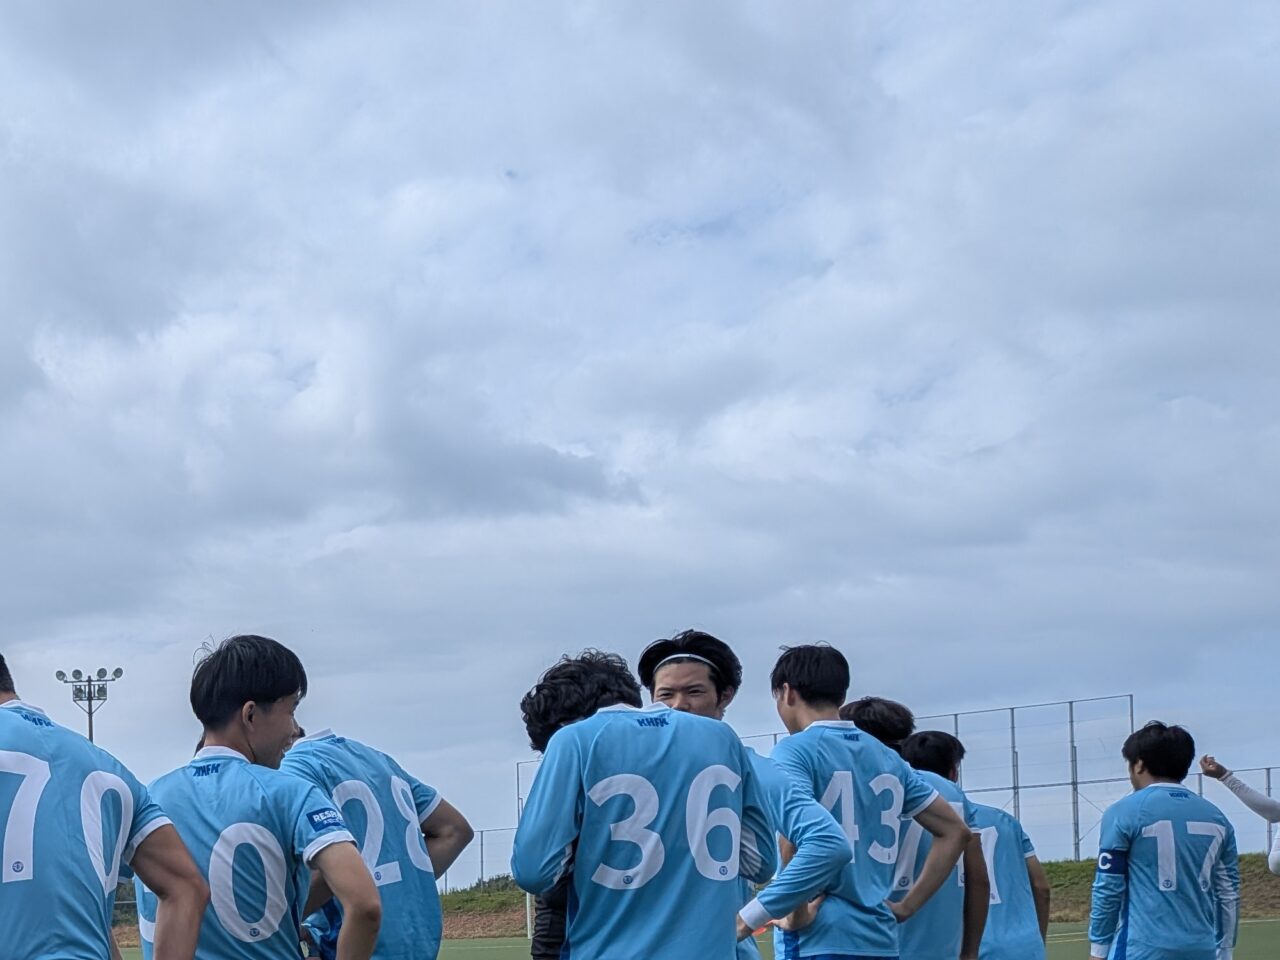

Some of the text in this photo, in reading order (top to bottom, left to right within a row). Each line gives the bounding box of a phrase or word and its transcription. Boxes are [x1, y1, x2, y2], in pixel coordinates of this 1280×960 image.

[332, 775, 434, 887] 28
[588, 764, 743, 890] 36
[820, 770, 905, 865] 43
[1098, 852, 1113, 870] C
[1141, 819, 1226, 892] 17
